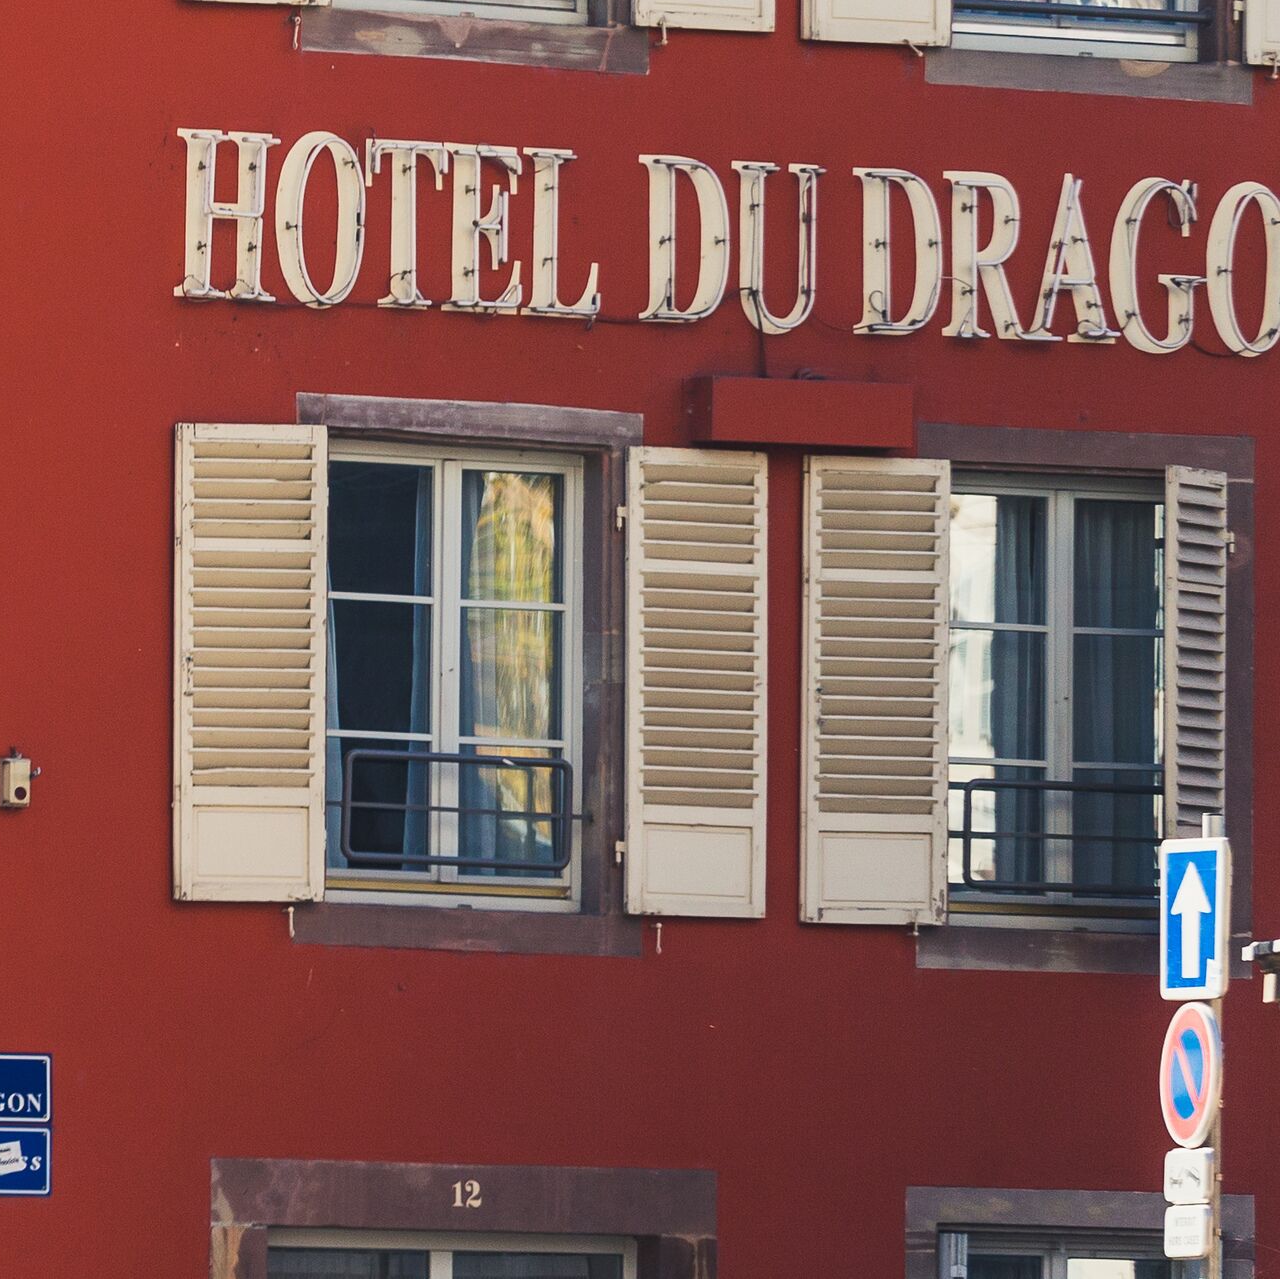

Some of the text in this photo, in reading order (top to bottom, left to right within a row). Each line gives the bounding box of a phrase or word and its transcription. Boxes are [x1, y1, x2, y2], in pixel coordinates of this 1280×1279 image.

[173, 127, 1280, 358] HOTEL DU DRAGO
[451, 1180, 482, 1208] 12
